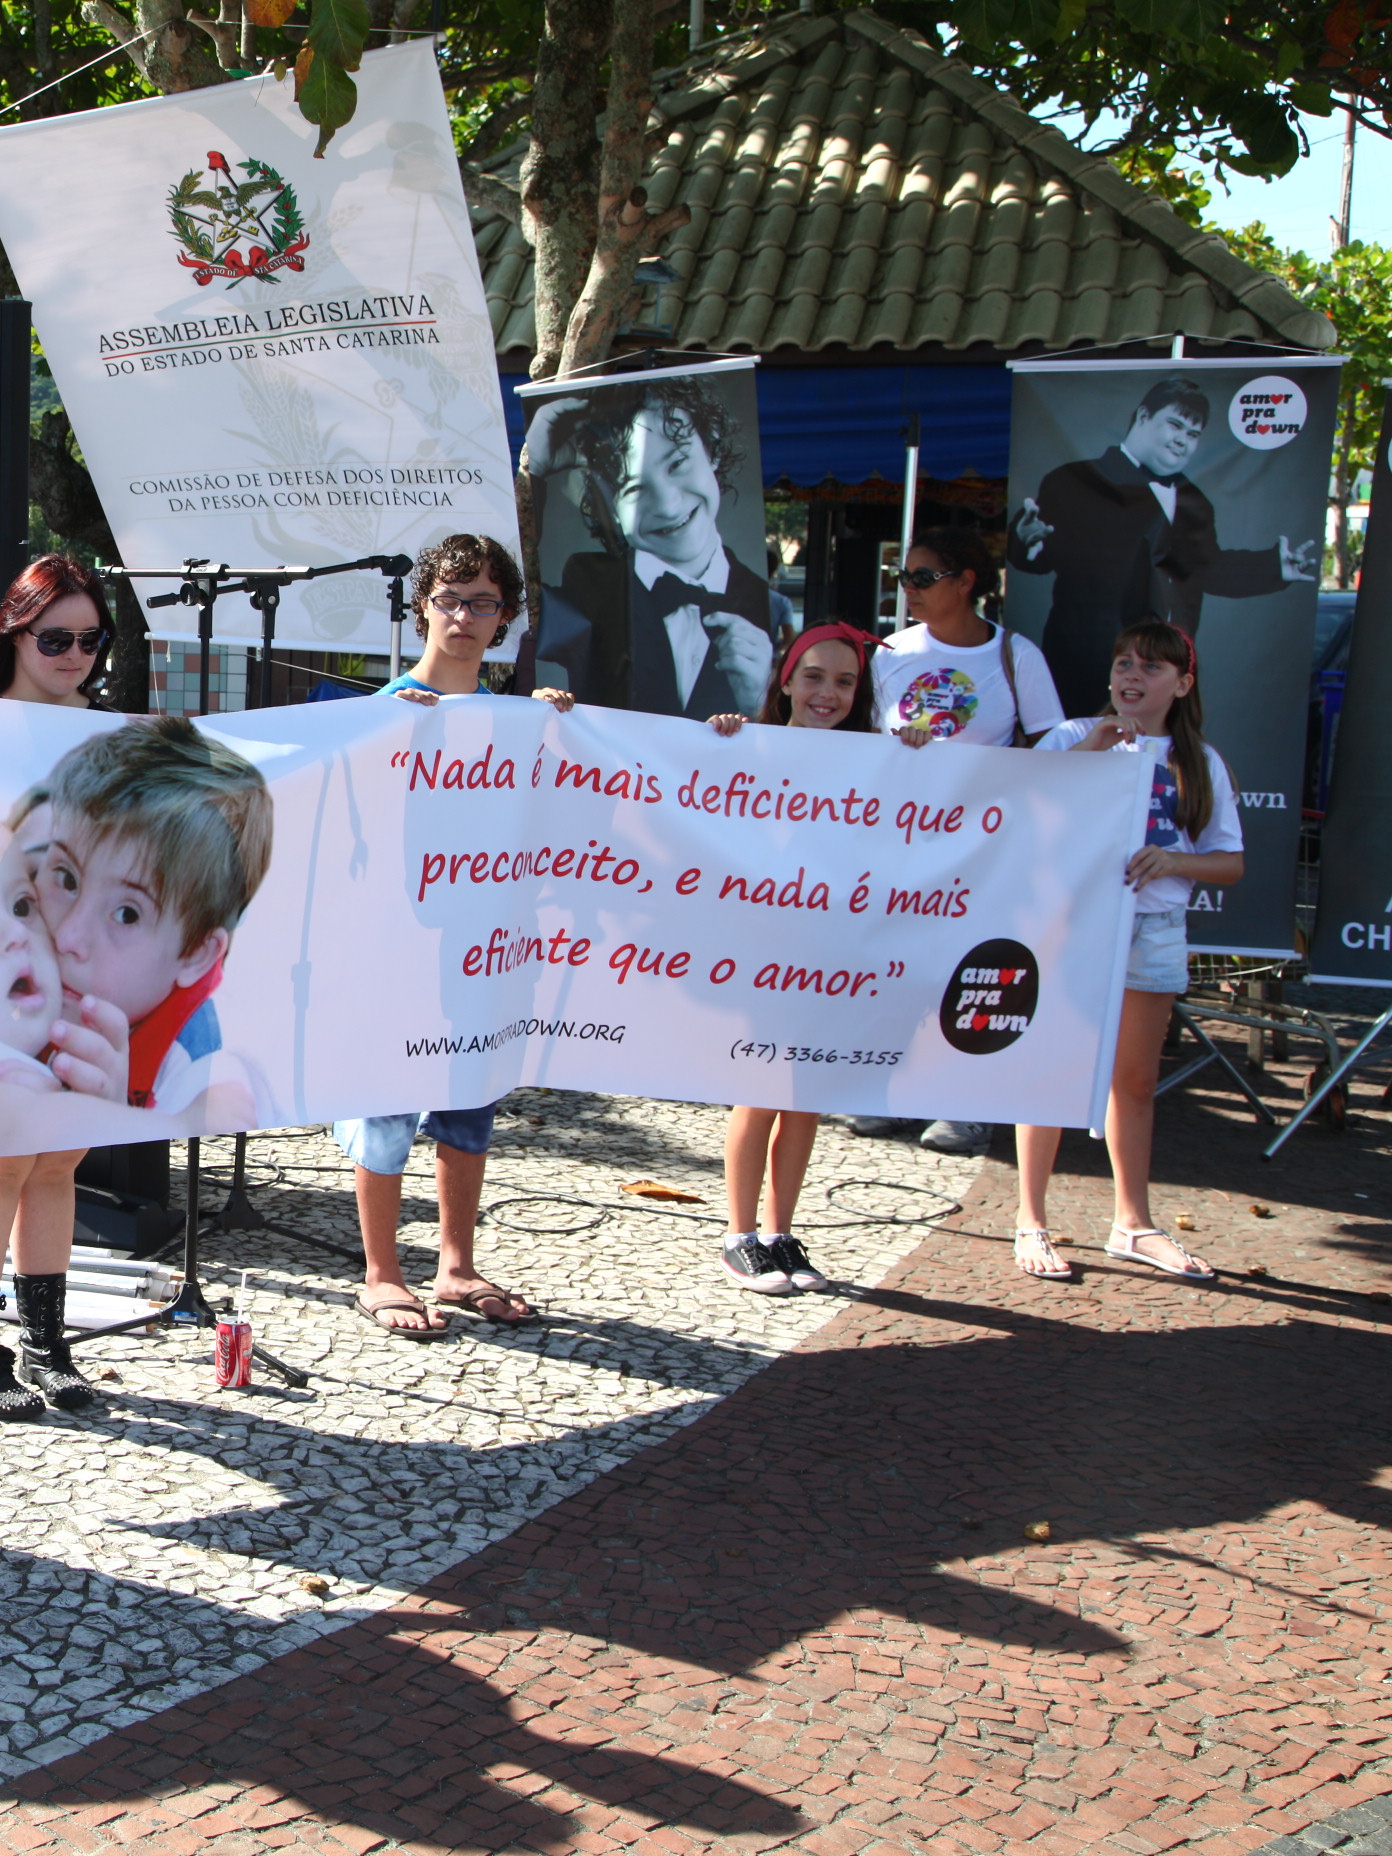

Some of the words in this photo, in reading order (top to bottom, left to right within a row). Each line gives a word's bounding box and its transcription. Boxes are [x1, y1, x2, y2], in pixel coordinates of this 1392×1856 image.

[195, 267, 225, 279] ESTADO
[227, 268, 239, 277] DE
[254, 265, 268, 275] STA
[98, 313, 259, 353] ASSEMBLEIA
[264, 294, 435, 330] LEGISLATIVA
[105, 359, 135, 377] DO
[141, 348, 223, 372] ESTADO
[228, 344, 258, 360] DE
[264, 335, 331, 357] SANTA
[337, 328, 440, 349] CATARINA
[1242, 407, 1276, 422] pra
[129, 473, 230, 496] COMISSÃO
[236, 473, 263, 488] DE
[268, 470, 338, 487] DEFESA
[343, 468, 384, 484] DOS
[389, 468, 484, 485] DIREITOS
[168, 497, 196, 512] DA
[202, 493, 270, 511] PESSOA
[273, 491, 322, 507] COM
[327, 487, 454, 507] DEFICIÊNCIA
[307, 580, 390, 615] ESTAD
[532, 743, 545, 788] é
[554, 759, 663, 803] mais
[677, 770, 880, 827] deficiente
[896, 801, 964, 844] que
[981, 806, 1003, 834] o
[417, 840, 653, 902] preconceito,
[675, 868, 701, 896] e
[718, 866, 830, 911] nada
[849, 870, 871, 913] é
[886, 877, 970, 918] mais
[462, 926, 591, 977] eficiente
[608, 943, 691, 985] que
[709, 957, 736, 984] o
[955, 989, 1003, 1011] pra
[406, 1018, 626, 1058] WWW.AMORPRADOWN.ORG
[729, 1039, 777, 1064] (47)
[784, 1046, 903, 1066] 3366-3155
